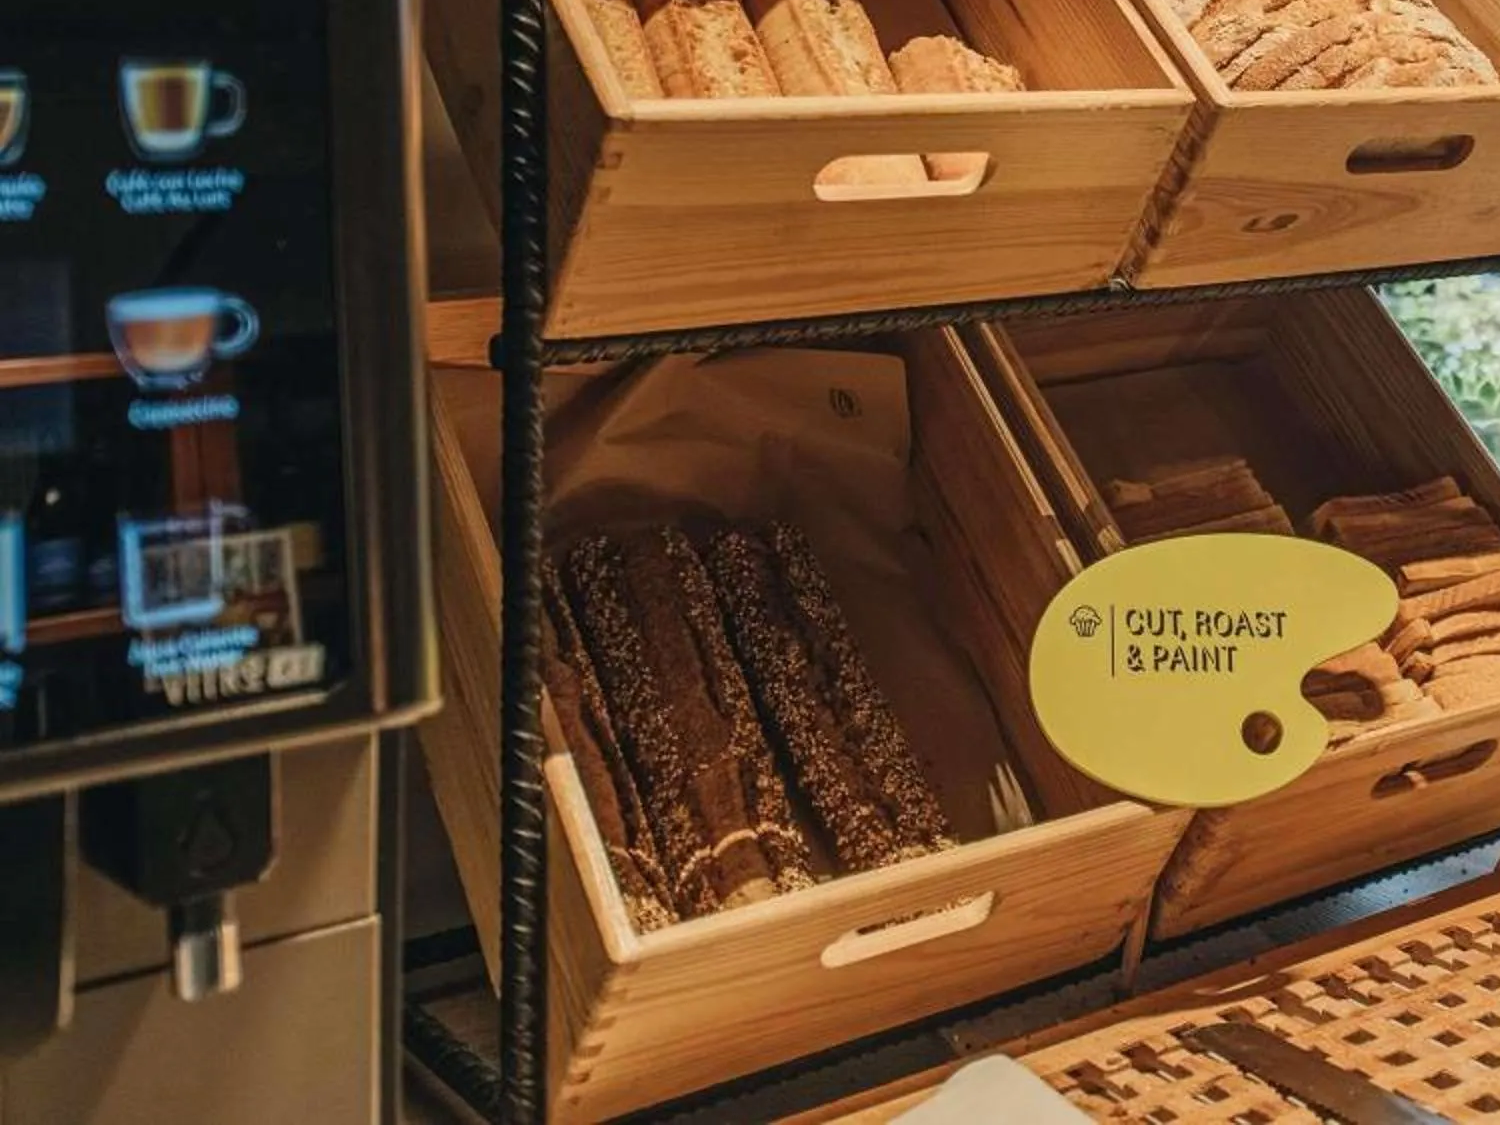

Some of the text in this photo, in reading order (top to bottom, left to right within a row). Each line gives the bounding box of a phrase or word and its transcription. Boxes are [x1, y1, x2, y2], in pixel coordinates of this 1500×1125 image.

[1125, 608, 1288, 641] CUT, ROAST
[1127, 643, 1239, 673] & PAINT
